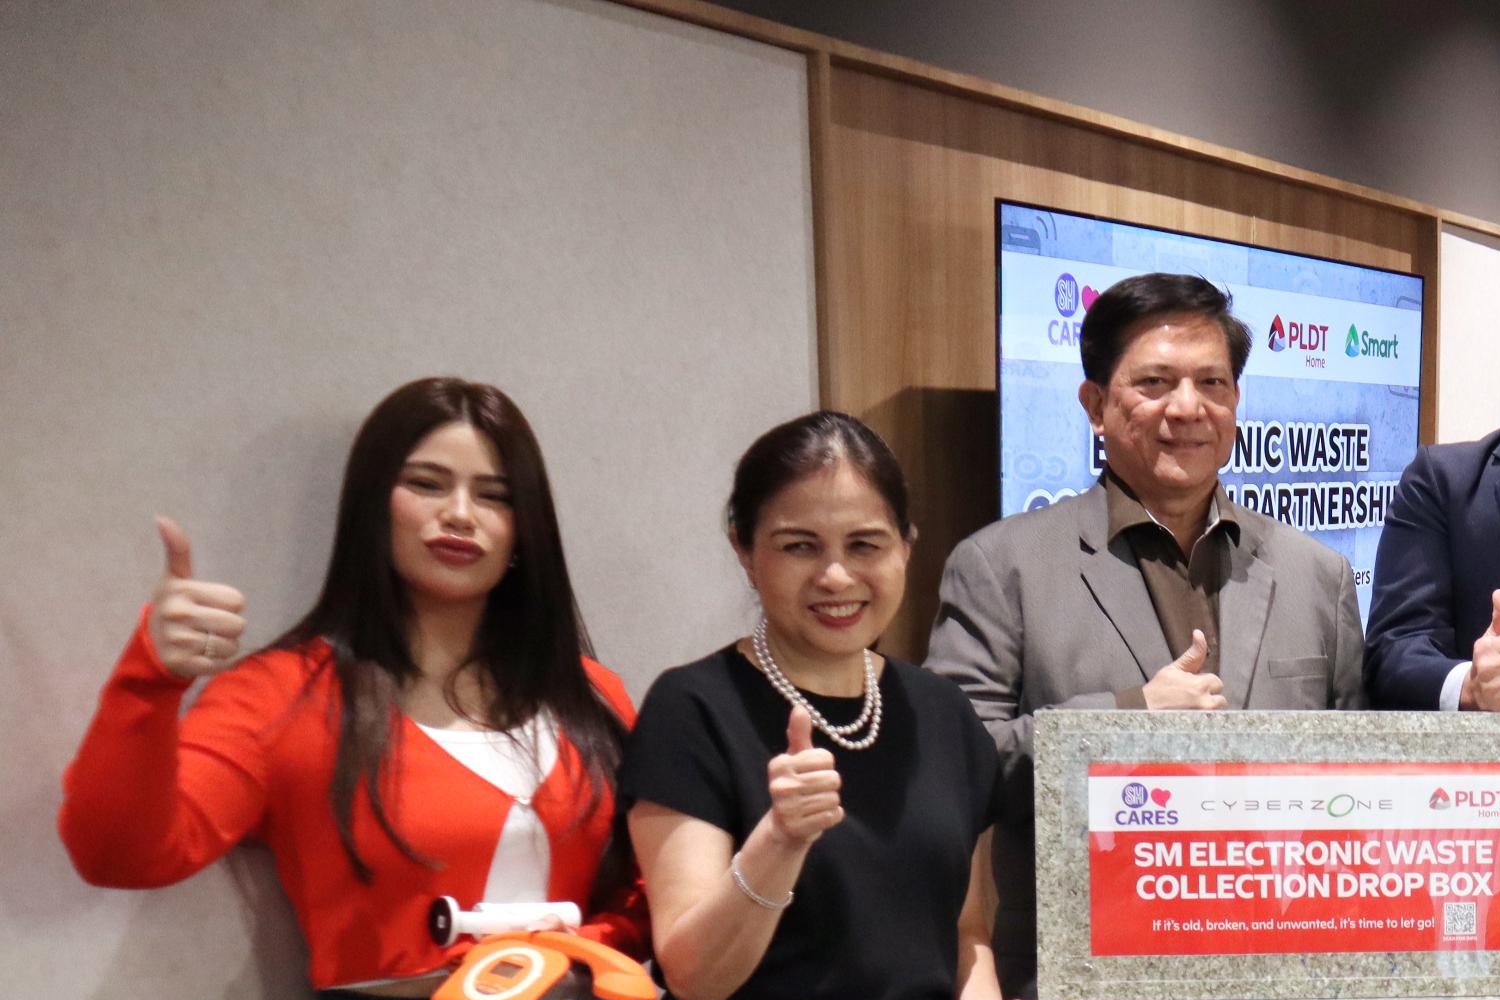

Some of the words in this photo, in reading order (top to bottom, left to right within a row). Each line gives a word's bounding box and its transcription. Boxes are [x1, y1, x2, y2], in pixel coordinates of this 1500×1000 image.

[1048, 320, 1083, 346] CAR
[1289, 321, 1329, 351] PLDT
[1361, 331, 1398, 359] Smart
[1306, 355, 1326, 368] Home
[1288, 426, 1368, 468] WASTE
[1243, 485, 1397, 527] PARTNERSHI
[1115, 810, 1179, 826] CARES
[1201, 793, 1393, 818] CYBERZONE
[1134, 841, 1183, 867] SM
[1190, 840, 1381, 867] ELECTRONIC
[1385, 839, 1494, 865] WASTE
[1136, 873, 1330, 900] COLLECTION
[1337, 872, 1424, 898] DROP
[1430, 871, 1493, 897] BOX
[1152, 920, 1161, 931] If
[1182, 919, 1204, 932] old,
[1206, 919, 1249, 931] broken,
[1252, 918, 1274, 930] and
[1277, 917, 1337, 930] unwanted,
[1358, 917, 1384, 929] time
[1386, 917, 1398, 929] to
[1401, 917, 1415, 928] let
[1417, 917, 1435, 930] go!
